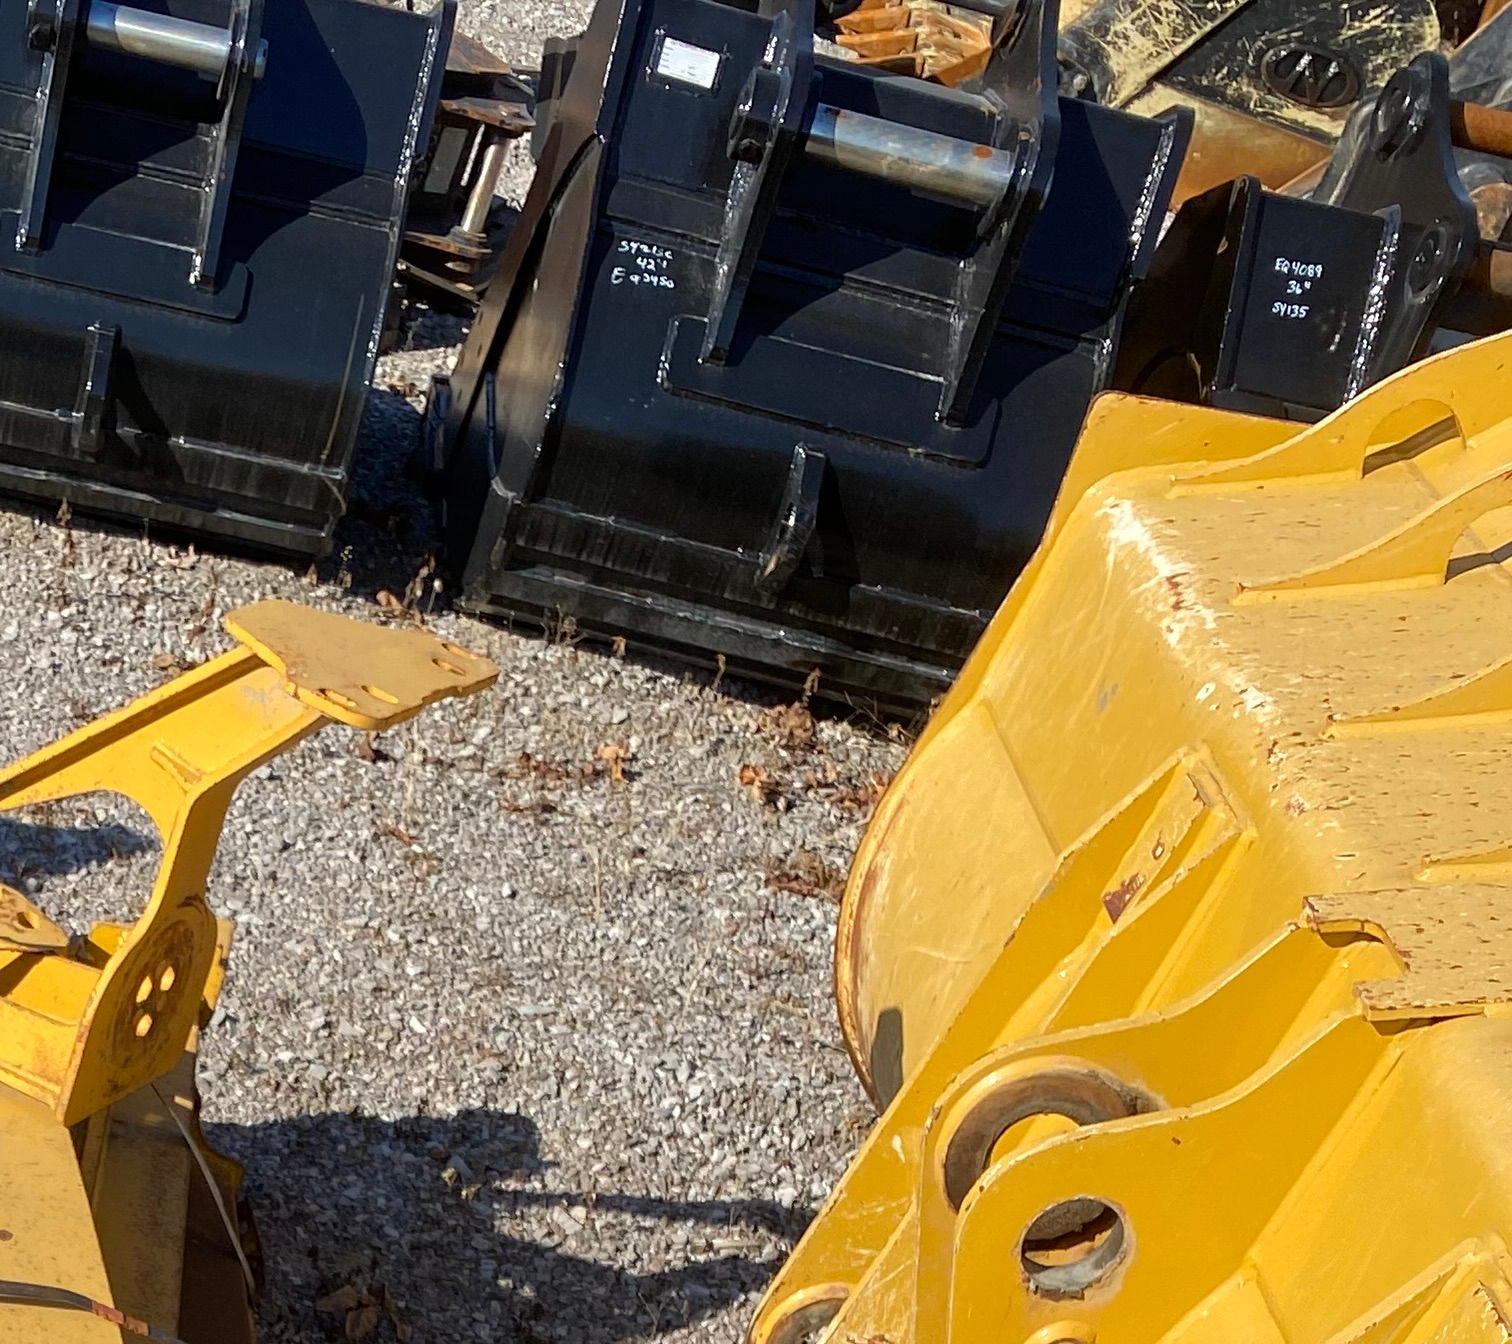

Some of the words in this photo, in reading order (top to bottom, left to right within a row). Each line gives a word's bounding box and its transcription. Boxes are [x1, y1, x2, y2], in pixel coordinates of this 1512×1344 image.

[1275, 257, 1323, 278] EQ4089
[1286, 280, 1312, 294] 36"
[1271, 302, 1310, 318] SY135
